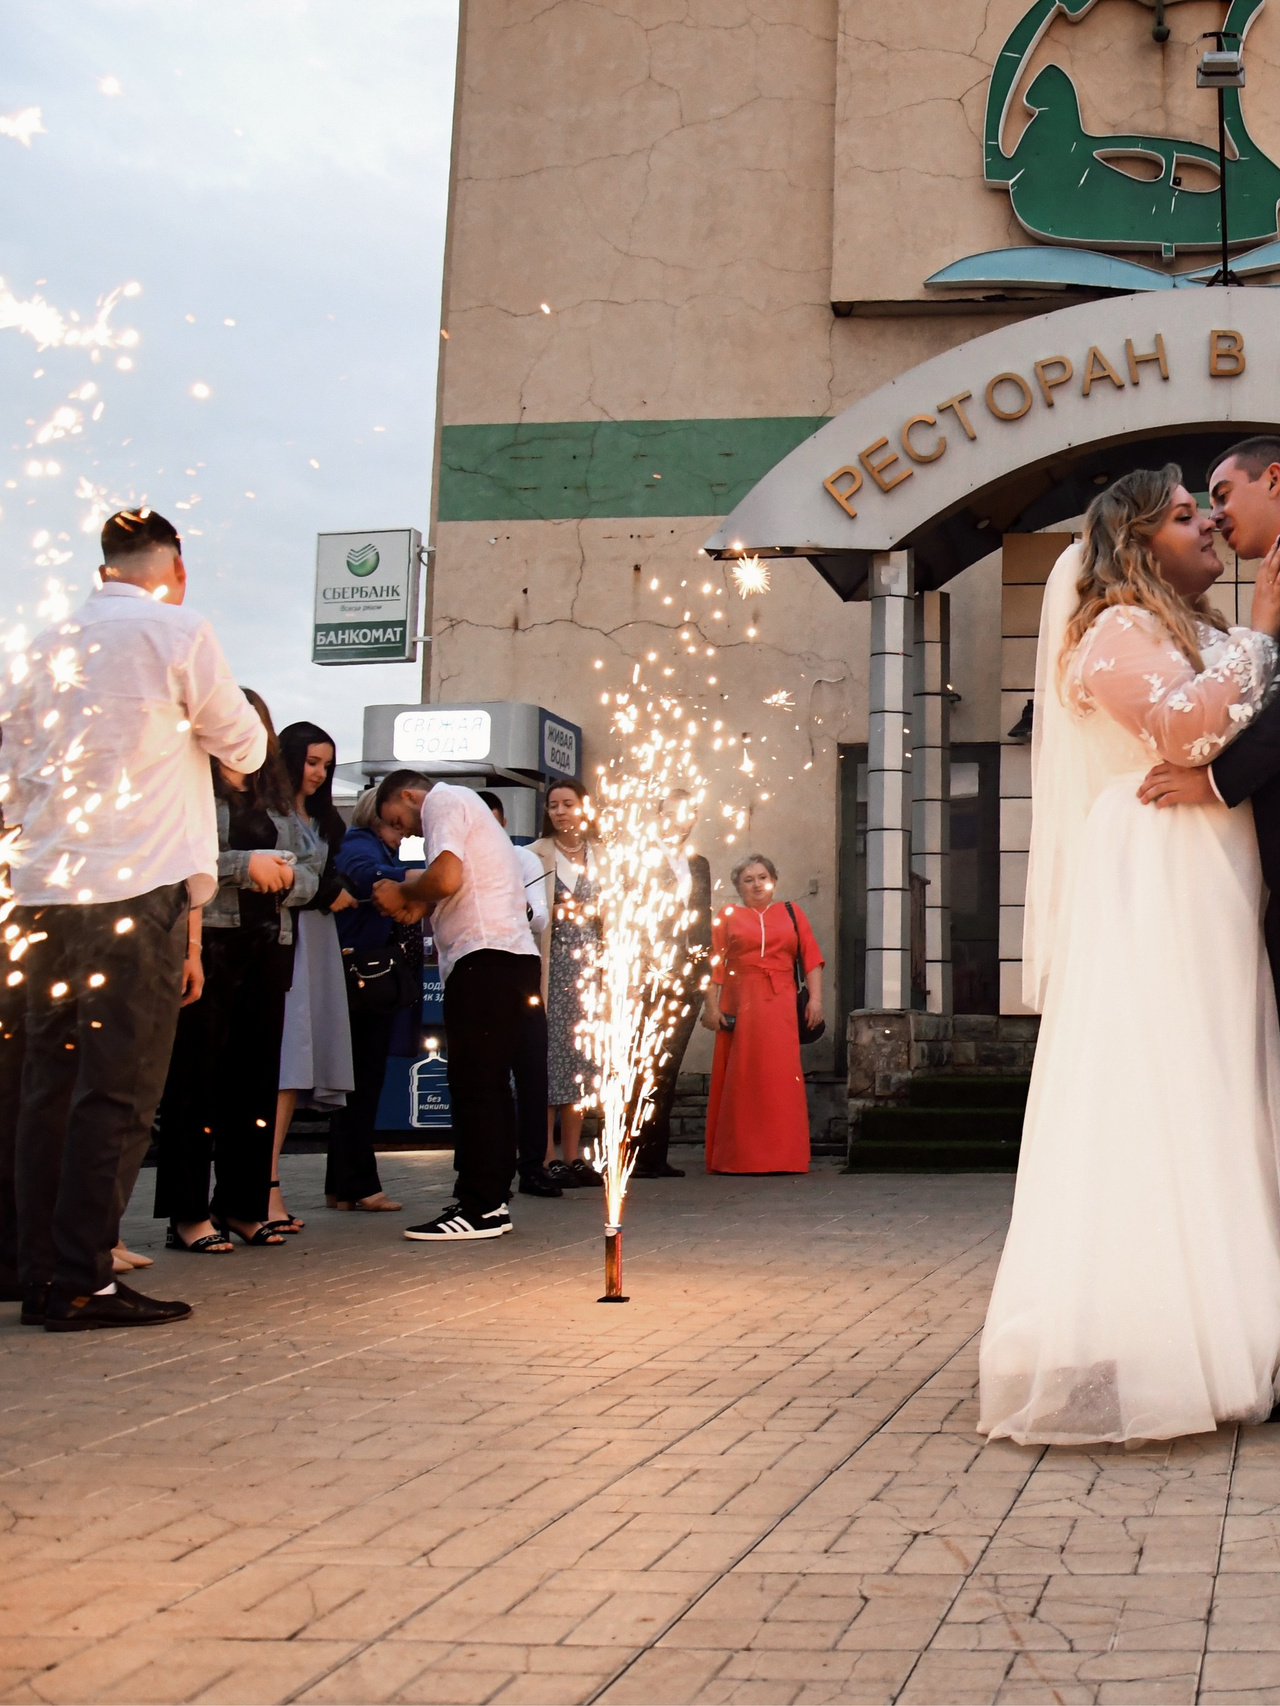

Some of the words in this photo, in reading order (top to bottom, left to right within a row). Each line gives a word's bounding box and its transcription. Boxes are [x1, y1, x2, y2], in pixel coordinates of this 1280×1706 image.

[822, 332, 1170, 518] РЕСТОРАН
[1208, 330, 1246, 377] В
[322, 585, 401, 600] СБЕРБАНК
[316, 627, 404, 645] БАНКОМАТ
[547, 724, 574, 751] ЖИВАЯ
[550, 746, 571, 770] ВОДА
[426, 1094, 442, 1103] без
